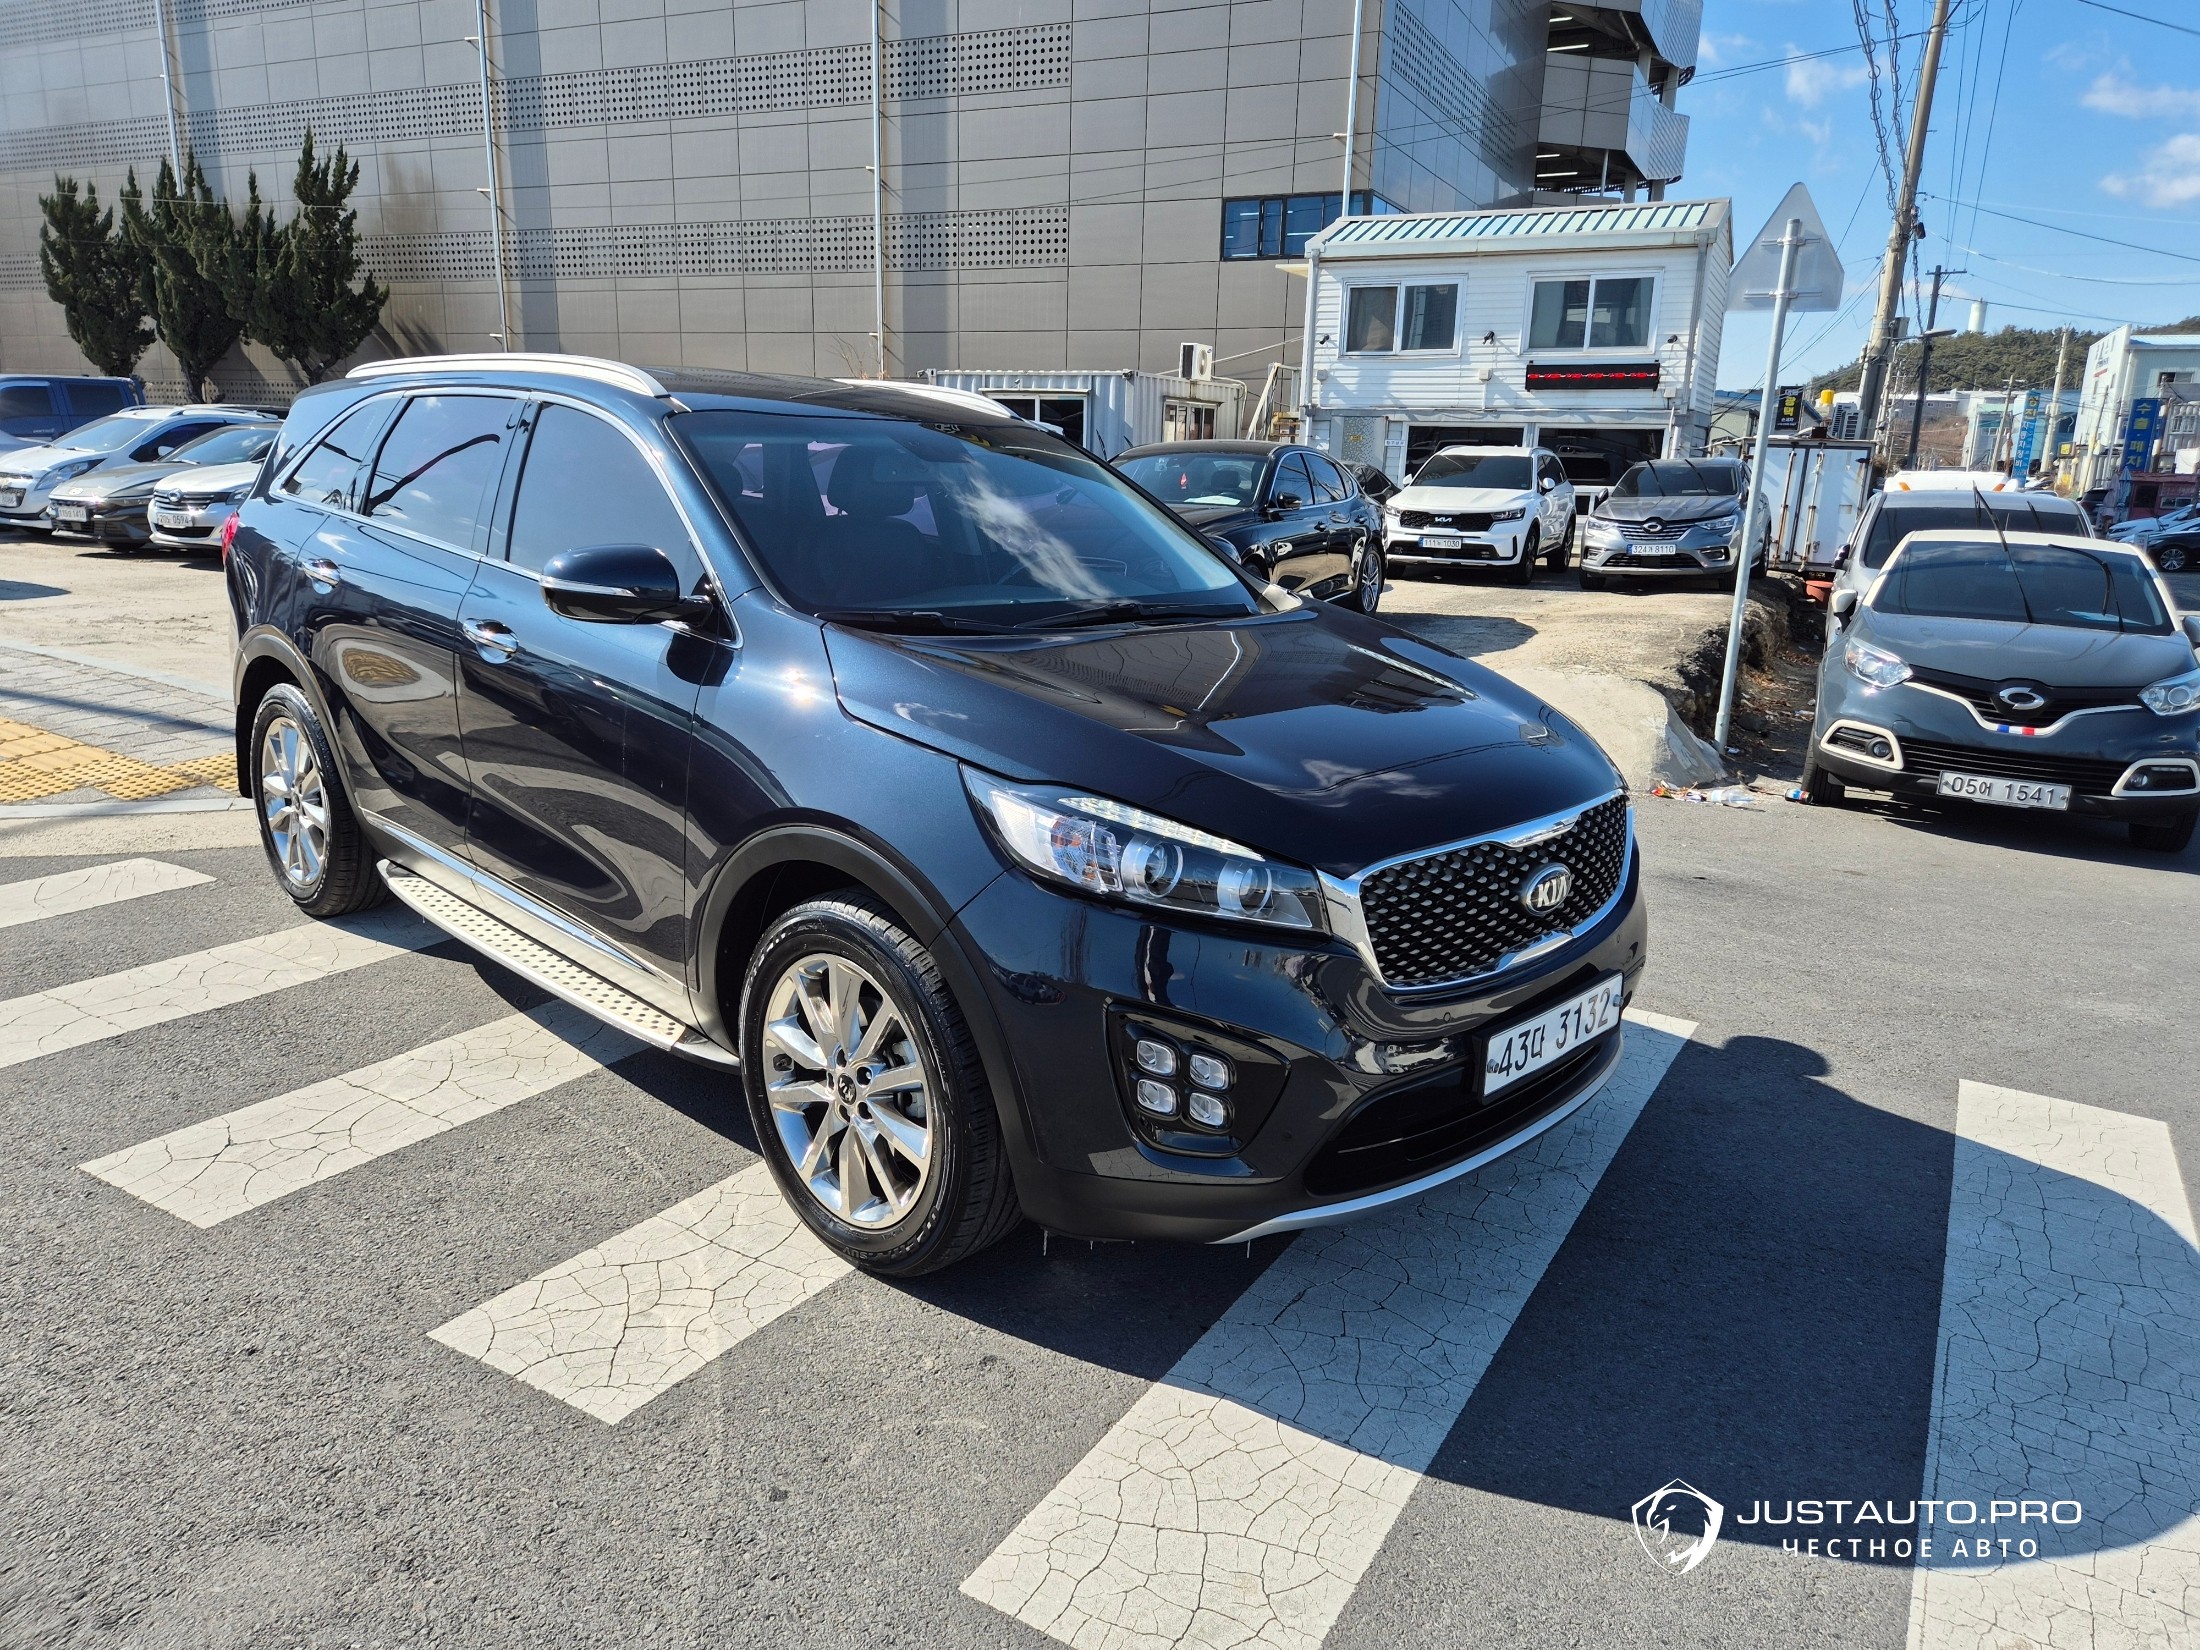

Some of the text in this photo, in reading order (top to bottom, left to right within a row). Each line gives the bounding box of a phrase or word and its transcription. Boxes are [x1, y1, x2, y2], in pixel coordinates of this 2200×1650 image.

[1443, 540, 1460, 548] 1030
[1655, 545, 1674, 554] 8110
[1951, 776, 2055, 806] 05어 1541
[1536, 874, 1569, 908] KIA
[1498, 987, 1611, 1077] 43다 3132
